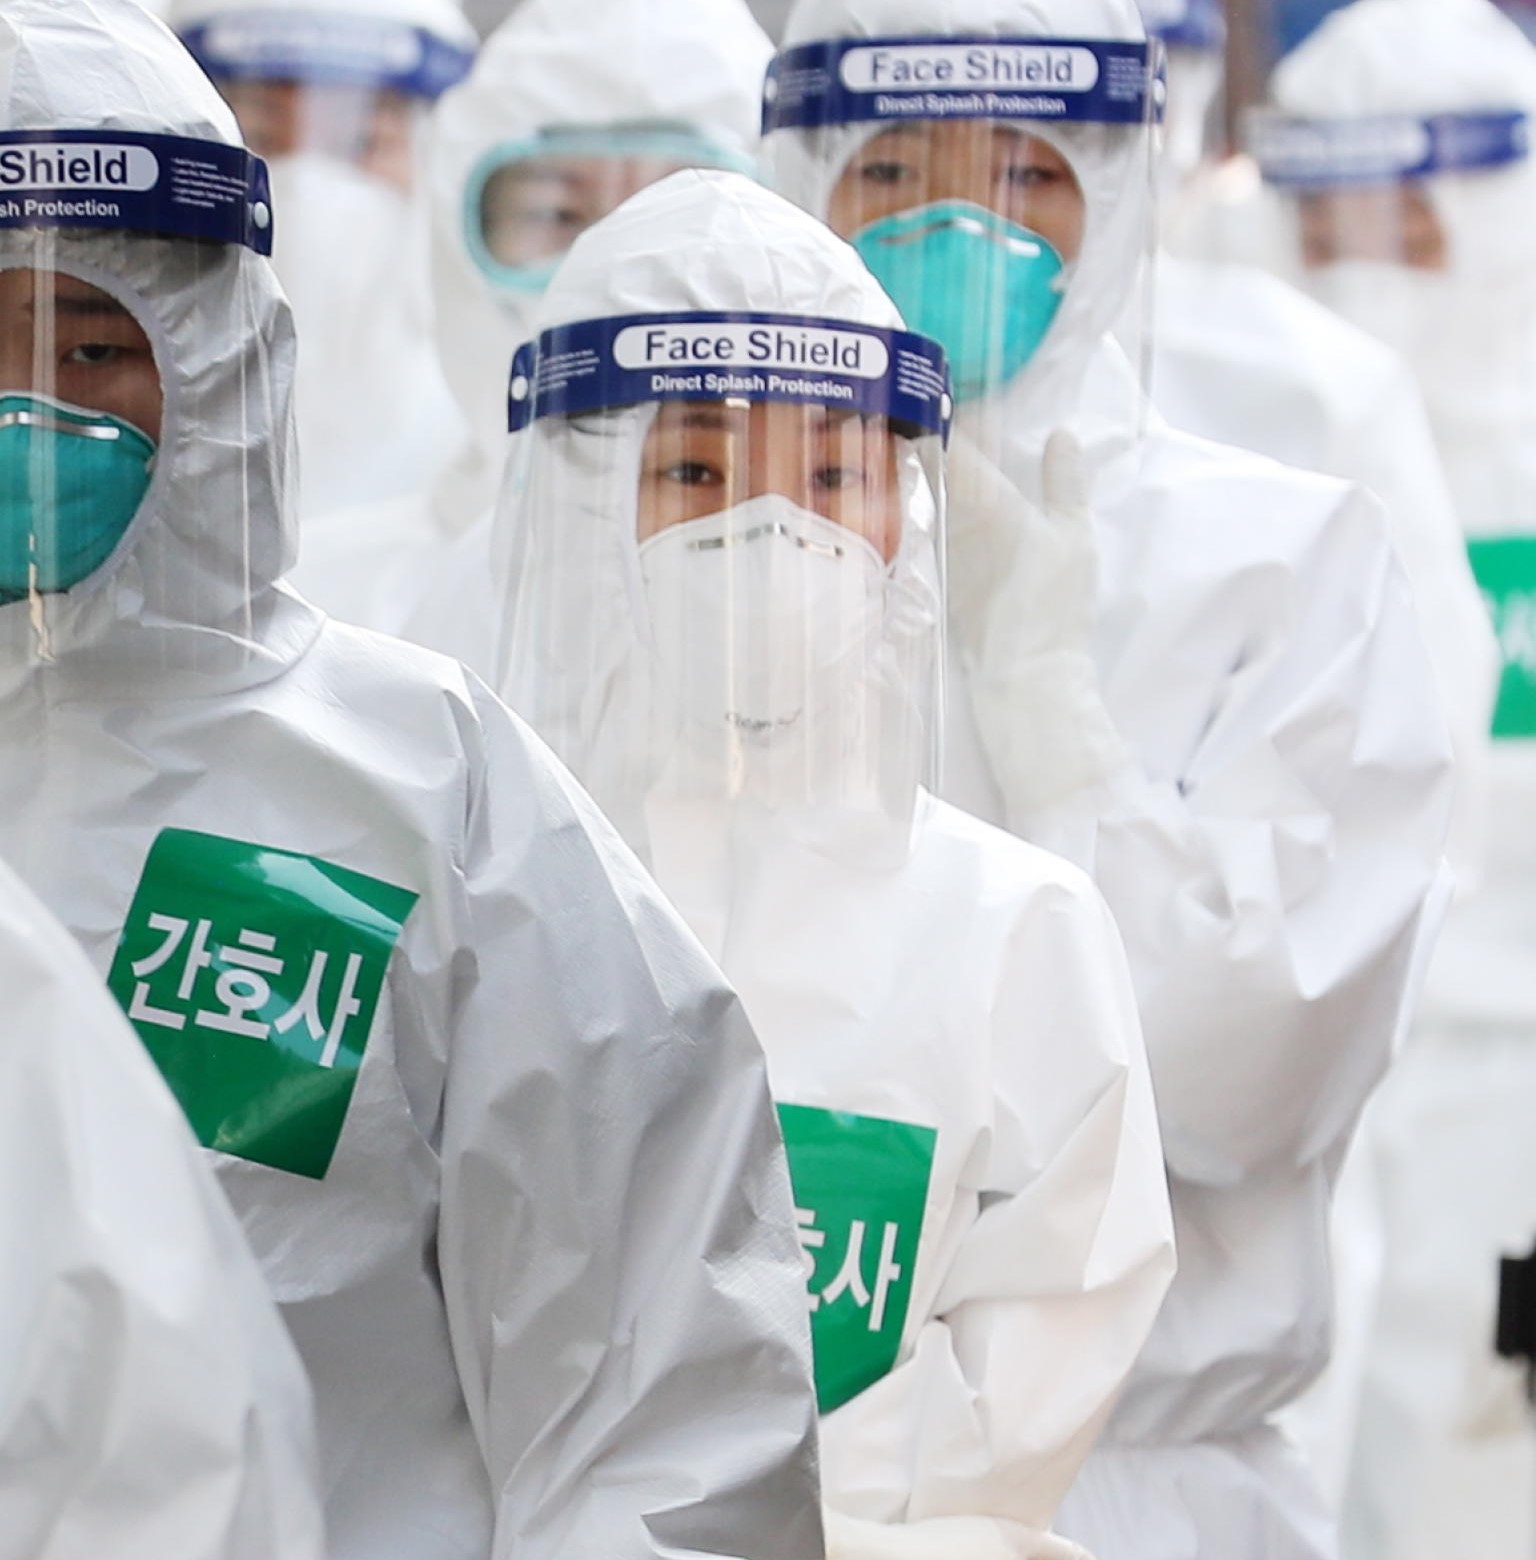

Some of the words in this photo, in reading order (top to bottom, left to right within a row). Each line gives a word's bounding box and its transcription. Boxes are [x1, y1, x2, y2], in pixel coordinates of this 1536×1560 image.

[871, 51, 953, 82] Face
[966, 50, 1073, 82] Shield
[876, 94, 924, 114] Direct
[925, 93, 984, 116] Splash
[986, 93, 1067, 114] Protection
[24, 198, 120, 218] Protection
[645, 331, 735, 361] Face
[747, 329, 861, 369] Shield
[651, 374, 702, 392] Direct
[705, 373, 765, 393] Splash
[768, 374, 853, 399] Protection
[128, 911, 363, 1069] 간호사
